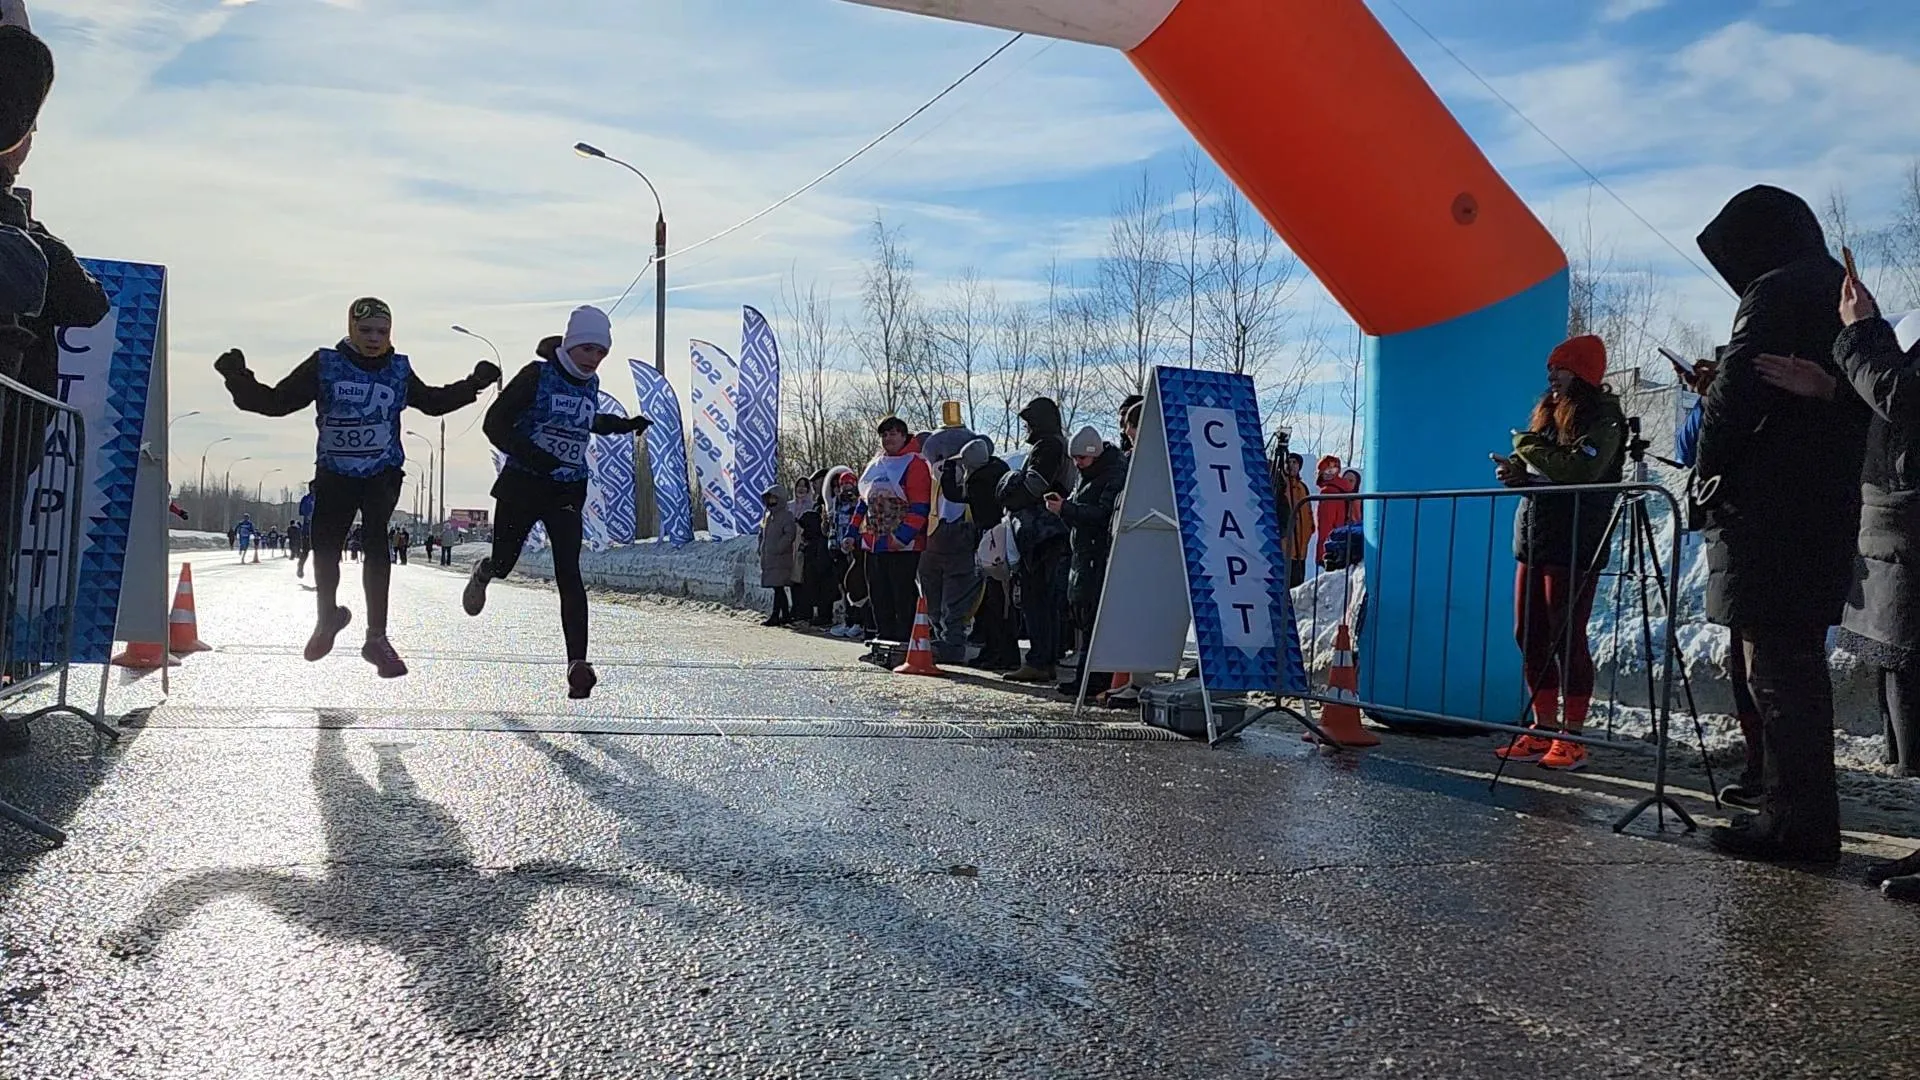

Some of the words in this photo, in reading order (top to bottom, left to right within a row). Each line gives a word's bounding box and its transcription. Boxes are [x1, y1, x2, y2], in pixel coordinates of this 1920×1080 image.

[338, 386, 364, 396] bella
[332, 428, 378, 447] 382
[548, 438, 579, 460] 398
[1203, 420, 1254, 634] СТАРТ
